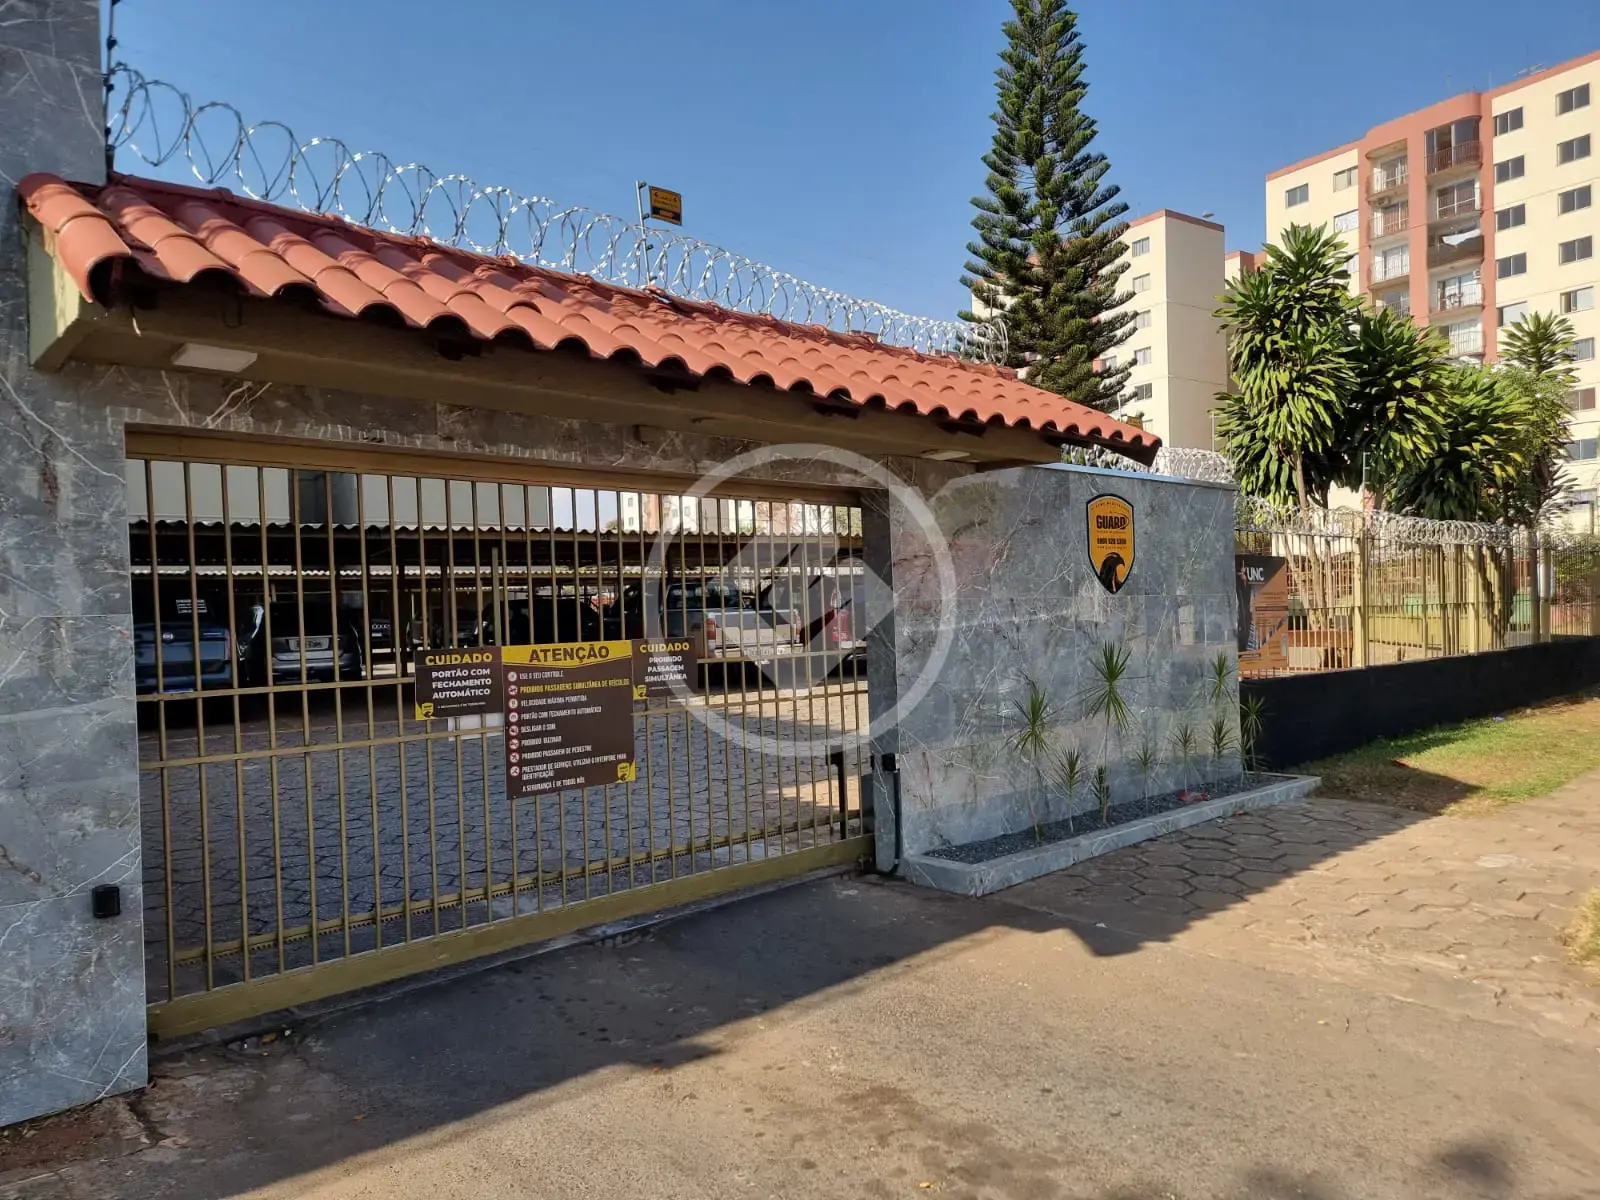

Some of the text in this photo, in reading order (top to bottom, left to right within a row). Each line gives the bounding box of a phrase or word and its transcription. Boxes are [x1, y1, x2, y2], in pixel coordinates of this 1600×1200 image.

[1096, 515, 1127, 530] GUARD
[529, 643, 610, 663] ATENÇÃO
[640, 642, 690, 653] CUIDADO
[425, 652, 493, 666] CUIDADO
[649, 655, 682, 663] PROIBIDO
[431, 668, 490, 678] PORTÃO COM
[647, 664, 684, 672] PASSAGEM
[520, 672, 528, 680] USE
[542, 670, 564, 678] CONTROLE
[644, 672, 688, 682] SIMULTÂNEA
[432, 678, 492, 689] FECHAMENTO
[520, 684, 544, 694] PROIBIDO
[573, 680, 601, 689] SIMULTÂNEA
[608, 678, 630, 687] VEÍCULOS
[432, 688, 491, 699] AUTOMÁTICO
[521, 698, 546, 707] VELOCIDADE
[548, 696, 564, 704] MÁXIMA
[521, 711, 538, 720] PORTÃO
[549, 709, 576, 717] FECHAMENTO
[577, 705, 602, 714] AUTOMÁTICO
[521, 736, 562, 747] PROIBIDO BUZINAR
[522, 751, 542, 760] PROIBIDO
[543, 749, 565, 757] PASSAGEM
[572, 745, 592, 754] PEDESTRE
[522, 764, 547, 773] PRESTADOR
[573, 758, 591, 766] UTILIZAR
[522, 770, 554, 780] IDENTIFICAÇÃO
[527, 782, 552, 791] SEGURANÇA
